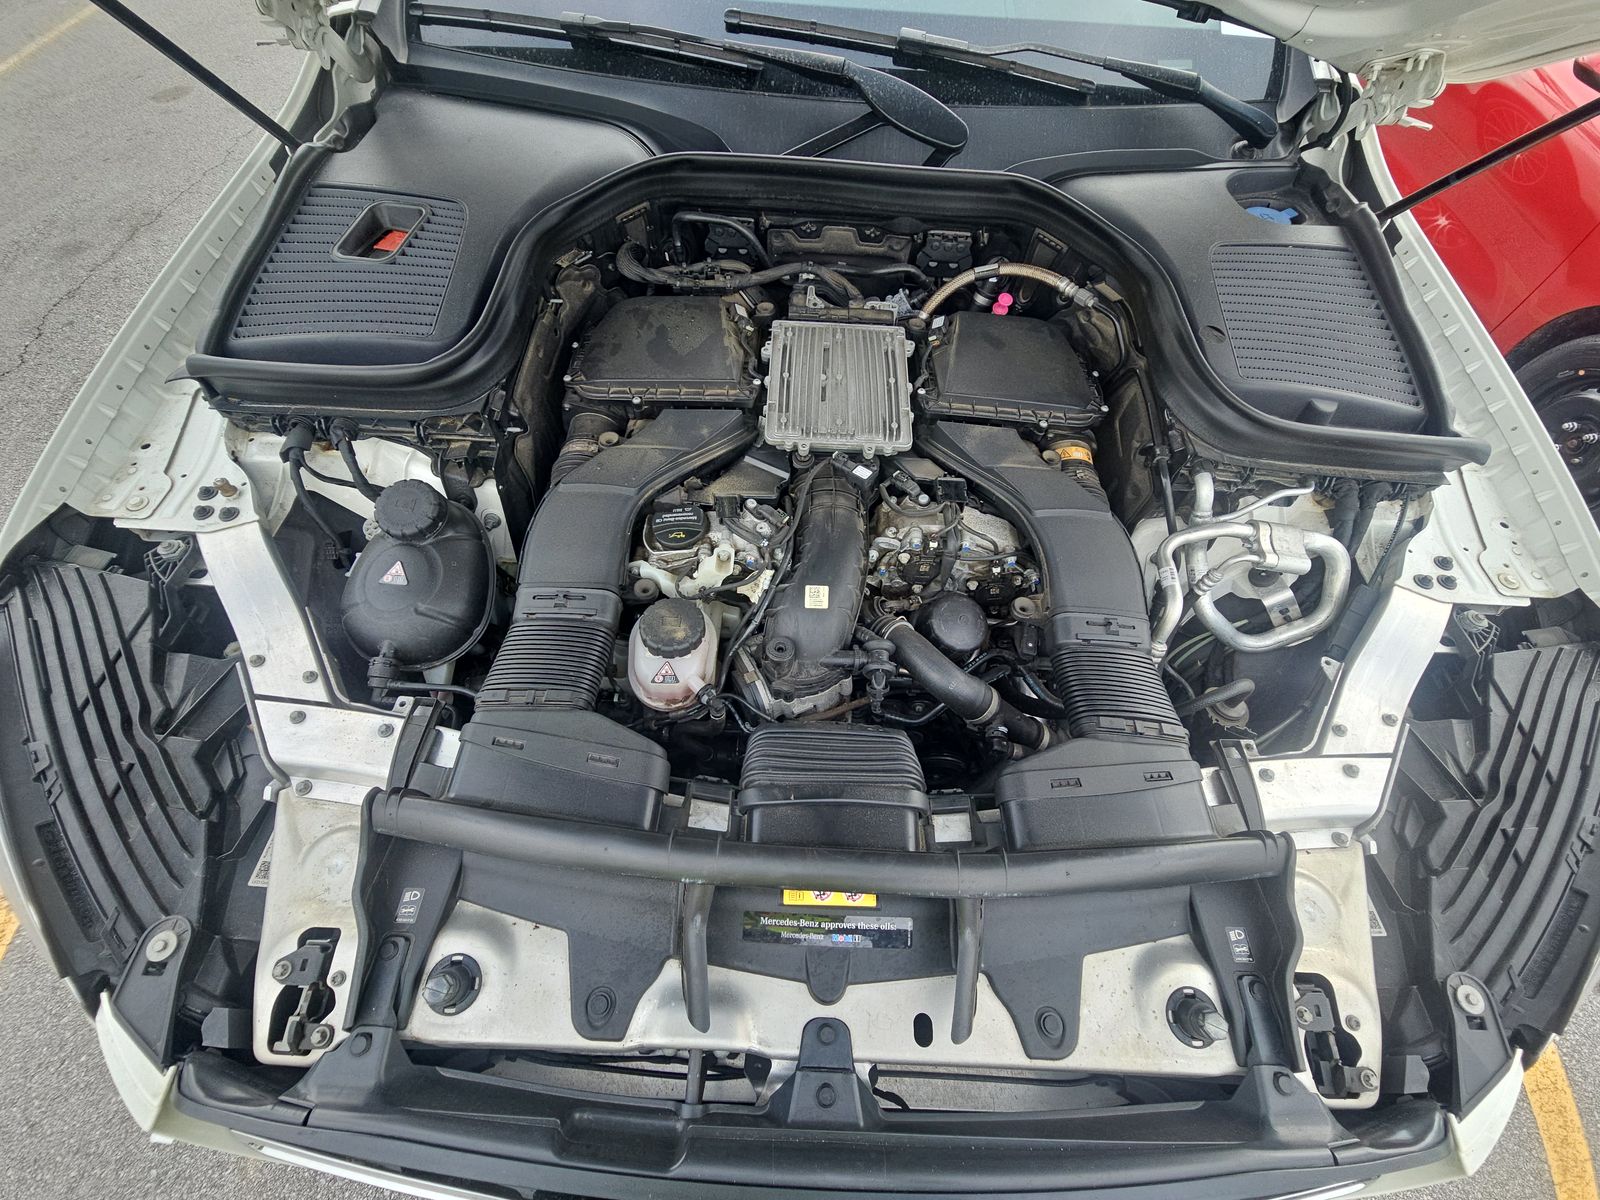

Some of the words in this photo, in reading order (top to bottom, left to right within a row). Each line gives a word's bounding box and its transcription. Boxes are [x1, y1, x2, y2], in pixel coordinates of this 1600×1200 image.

[760, 916, 819, 928] Mercedes-Benz
[820, 920, 856, 931] approves
[857, 921, 878, 930] these
[880, 922, 897, 931] oils:
[780, 930, 824, 940] Mercedes-Benz
